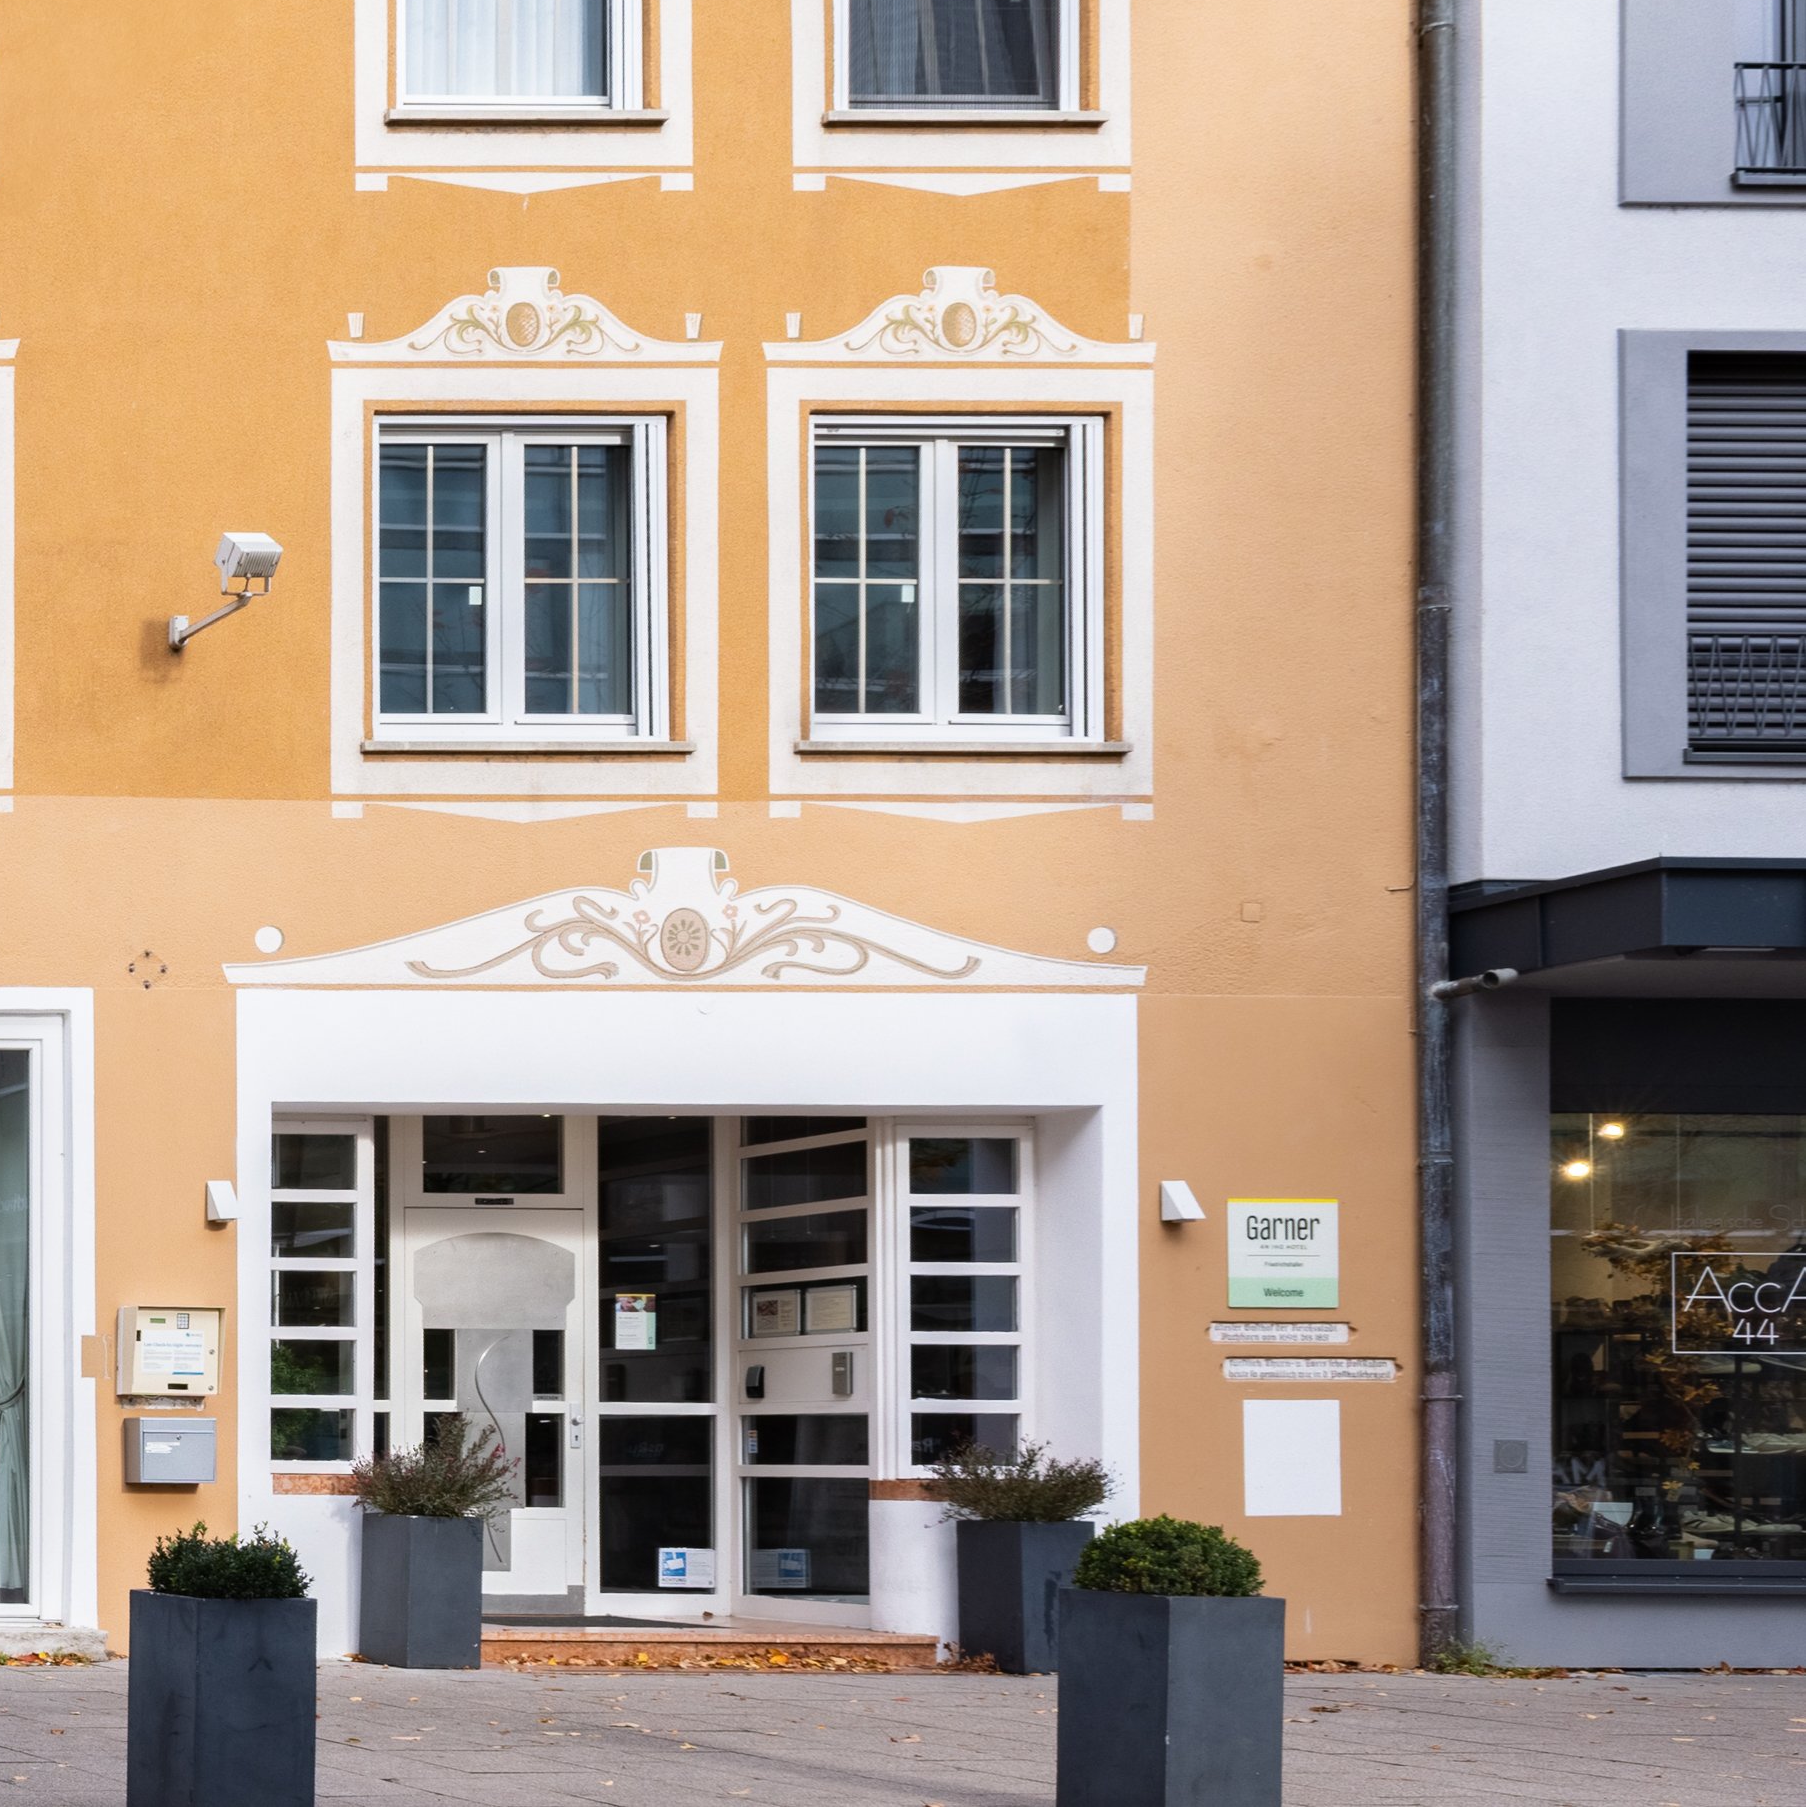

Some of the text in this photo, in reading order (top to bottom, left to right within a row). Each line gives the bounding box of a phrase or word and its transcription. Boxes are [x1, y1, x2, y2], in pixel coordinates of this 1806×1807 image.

[1246, 1215, 1320, 1240] Garner
[1263, 1287, 1305, 1298] Welcome
[1732, 1318, 1780, 1345] 44
